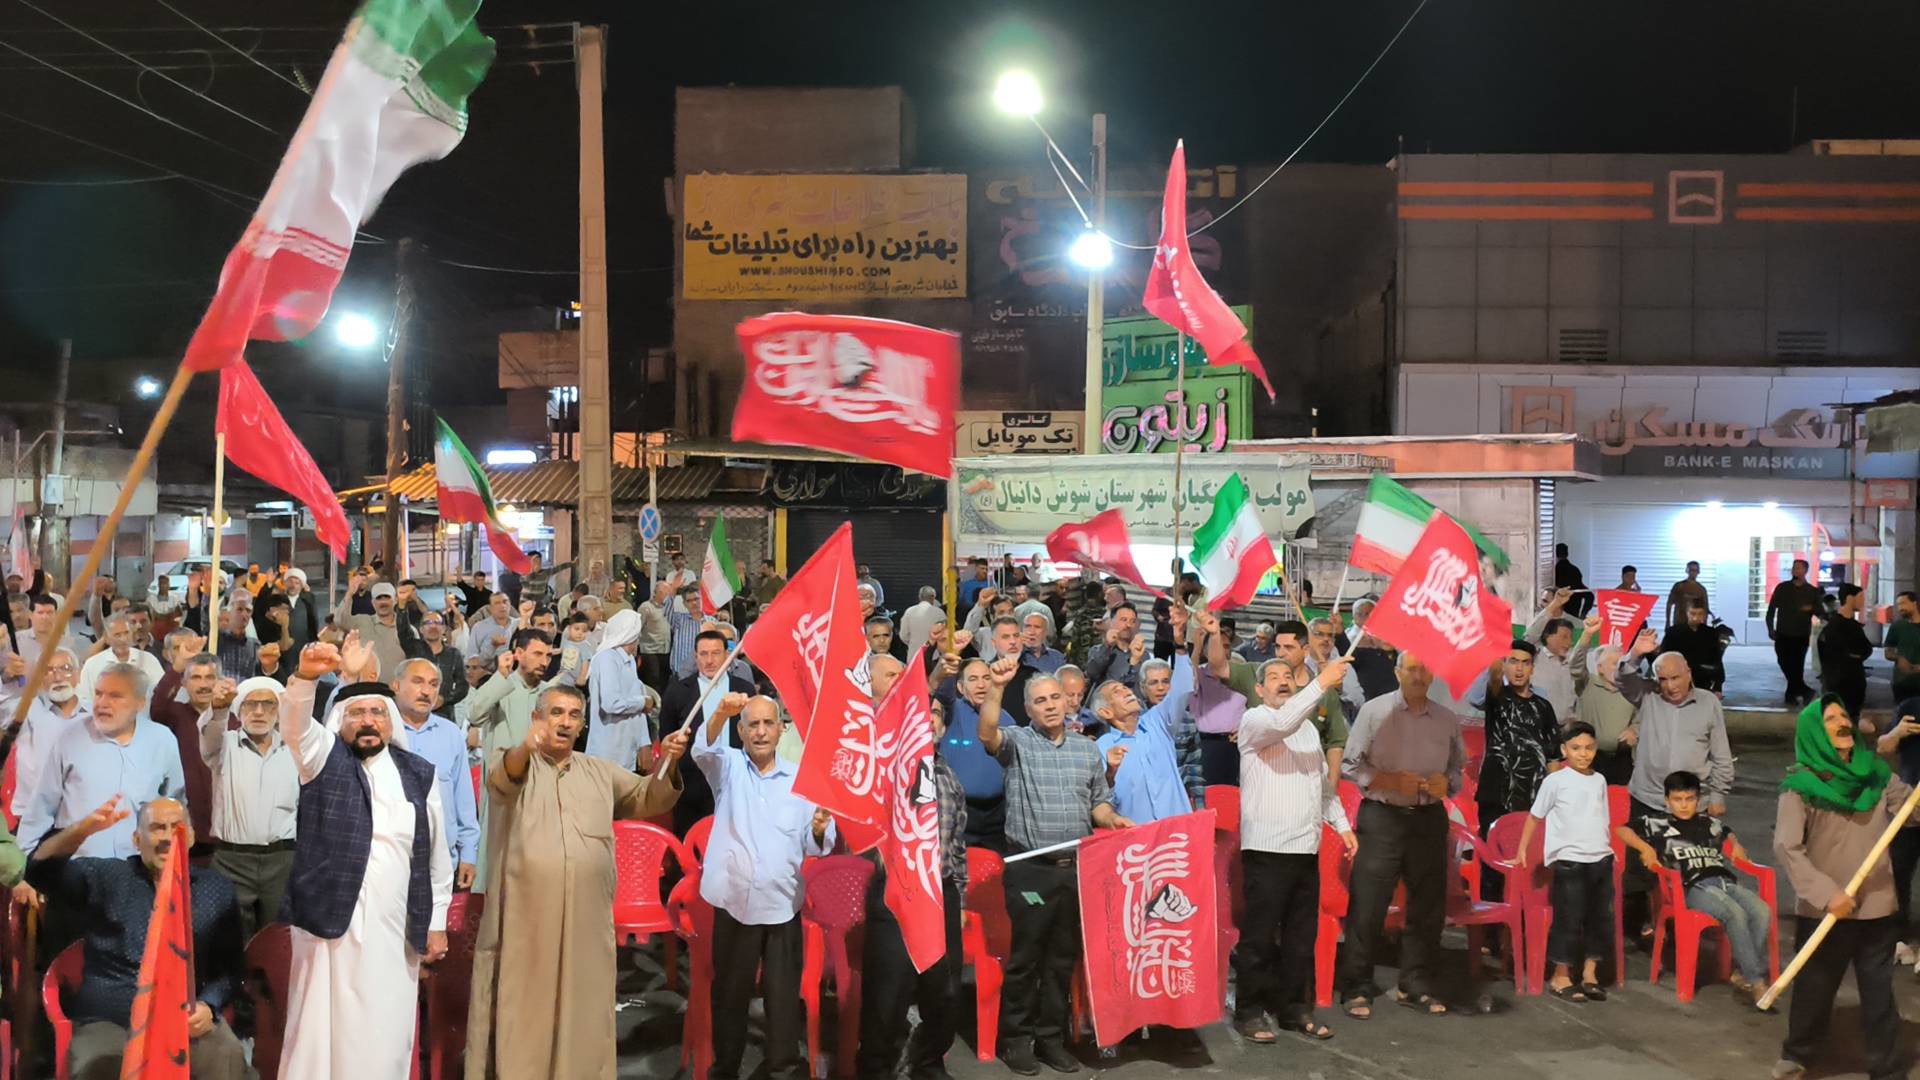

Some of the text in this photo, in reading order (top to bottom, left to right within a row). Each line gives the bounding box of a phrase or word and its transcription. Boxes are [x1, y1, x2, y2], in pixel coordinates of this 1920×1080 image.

[685, 220, 958, 264] بهترین راه برای تبلیغات شما
[990, 300, 1025, 323] سابق
[1103, 388, 1227, 453] زیتون
[977, 428, 1073, 448] تک موبایل
[1664, 455, 1824, 469] BANK-E MASKAN
[995, 479, 1042, 512] دانیال
[1046, 479, 1091, 512] شوش
[1095, 478, 1168, 512] شهرستان
[1171, 477, 1250, 512] فنگیان
